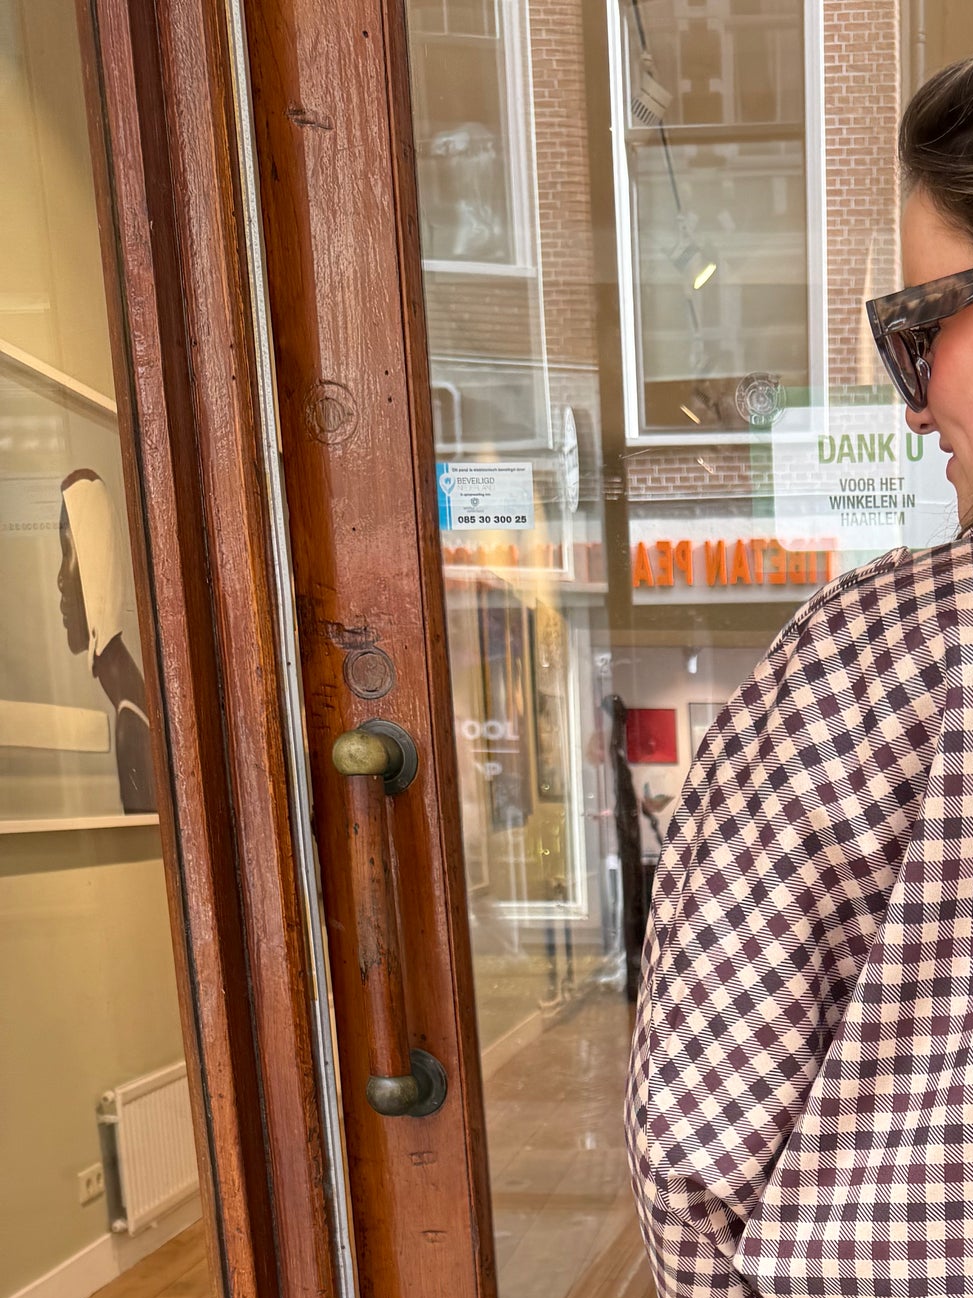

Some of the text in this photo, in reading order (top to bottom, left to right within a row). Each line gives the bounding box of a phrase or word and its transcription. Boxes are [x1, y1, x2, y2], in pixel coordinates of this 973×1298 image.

[817, 433, 924, 464] DANK U
[457, 477, 495, 485] BEVEILIGD
[839, 477, 905, 492] VOOR HET
[829, 494, 916, 510] WINKELEN IN
[457, 515, 527, 524] 085 30 300 25
[840, 511, 906, 527] HAARLEM
